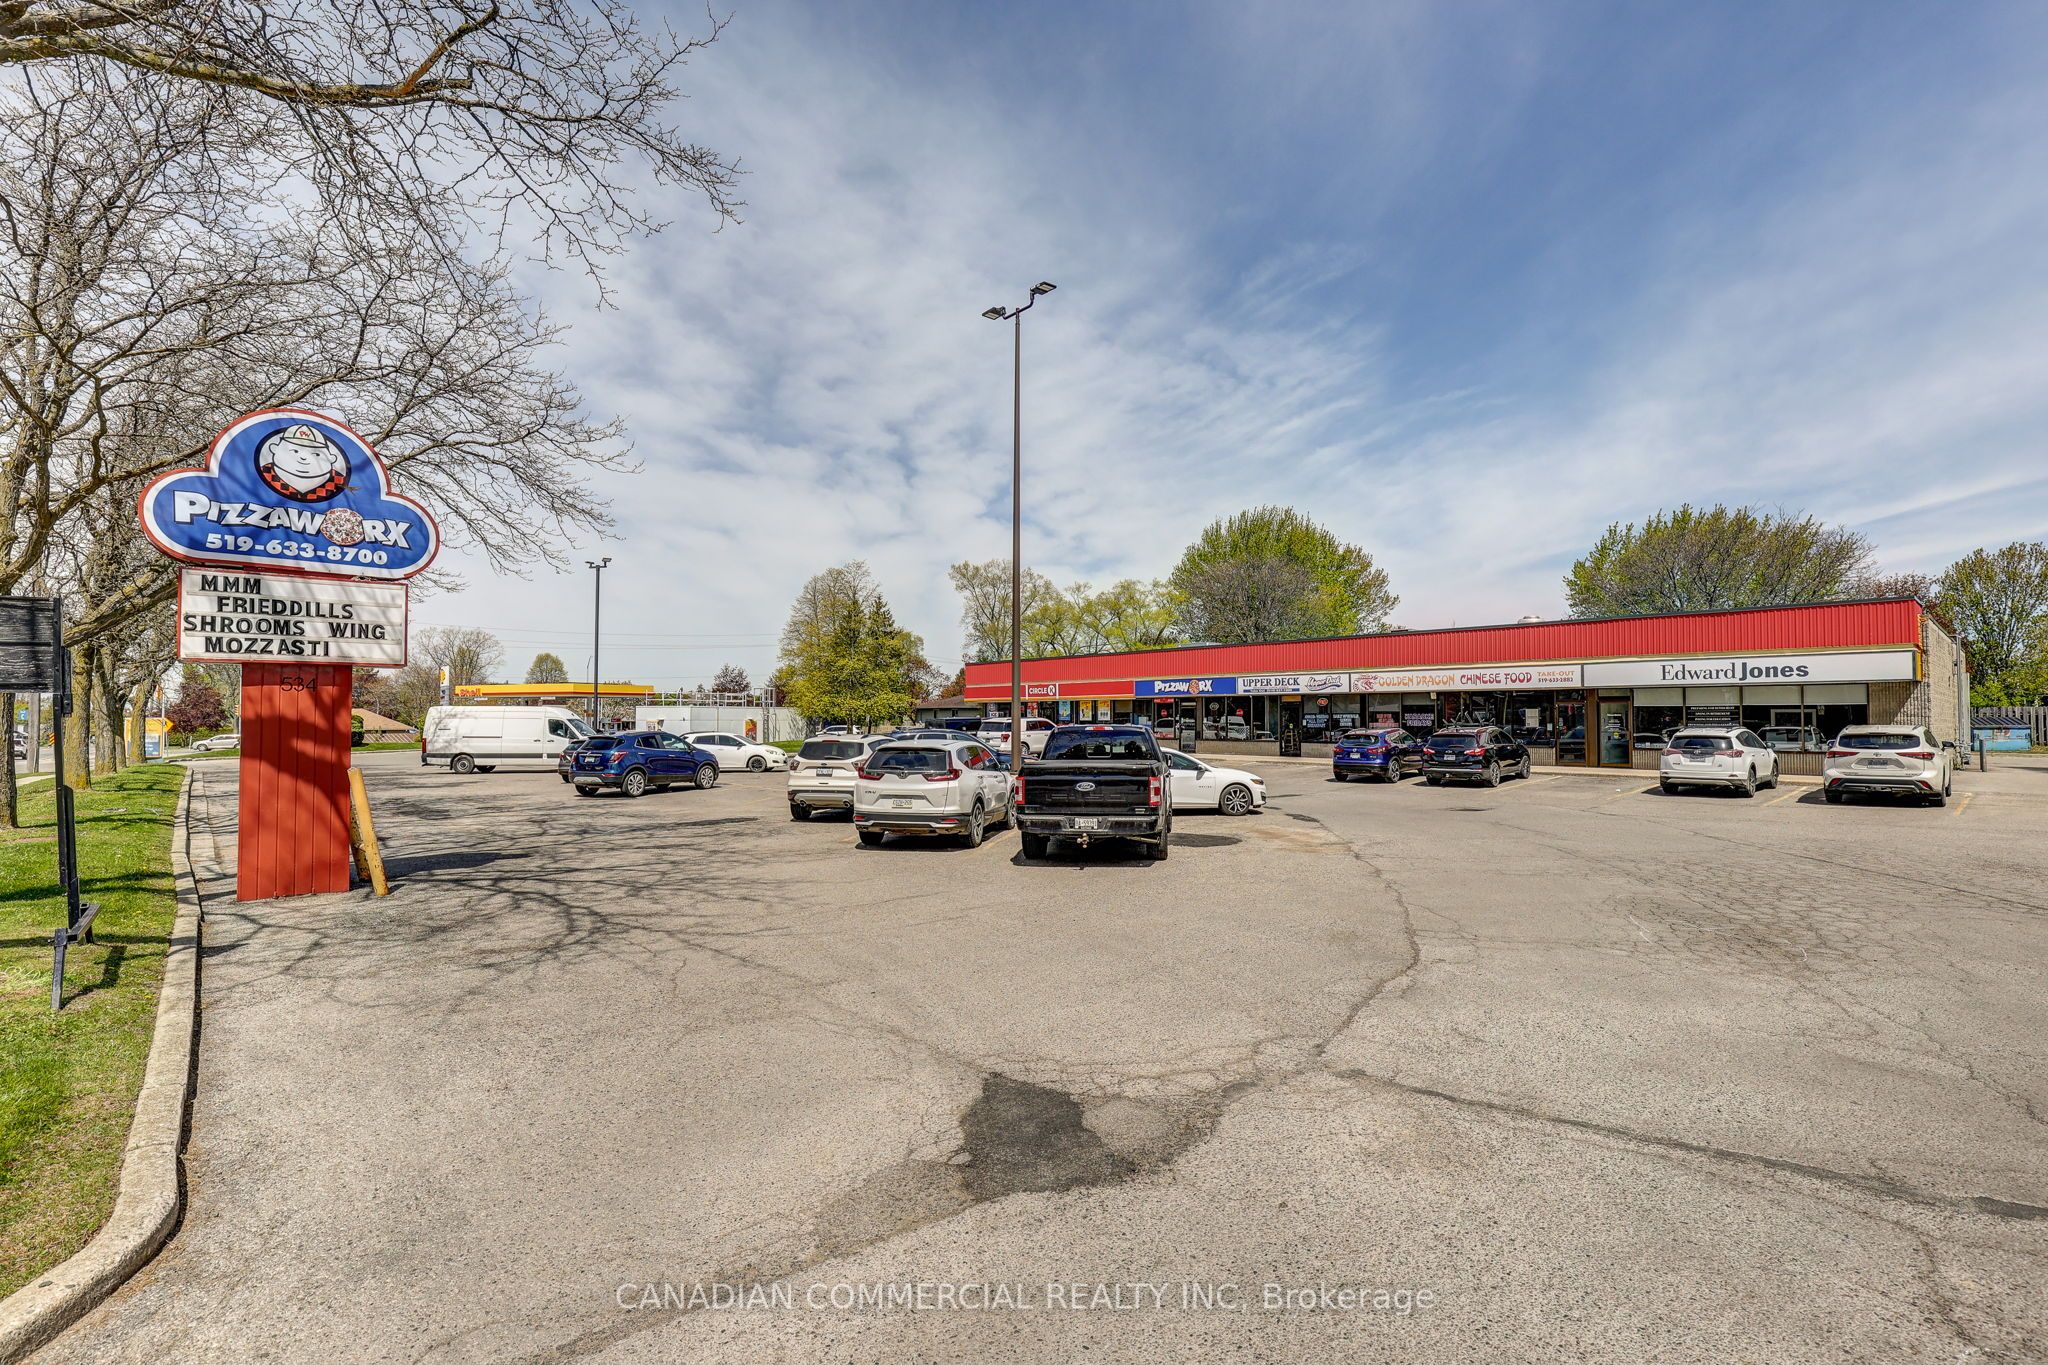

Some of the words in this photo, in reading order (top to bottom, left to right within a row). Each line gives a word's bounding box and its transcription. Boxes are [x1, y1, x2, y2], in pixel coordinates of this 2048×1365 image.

[205, 533, 388, 565] 519-633-8700
[200, 574, 261, 594] MMM
[183, 614, 305, 636] SHROOMS
[329, 622, 386, 640] WING
[204, 636, 329, 656] MOZZASTI
[1379, 675, 1414, 687] GOLDEN
[1416, 674, 1455, 687] DRAGON
[1460, 672, 1501, 685] CHINESE
[1504, 672, 1532, 685] FOOD
[1660, 662, 1736, 681] Edward
[1739, 662, 1809, 681] Jones
[281, 677, 318, 692] 534
[1048, 685, 1055, 695] K
[1243, 678, 1273, 688] UPPER
[1274, 677, 1300, 687] DECK
